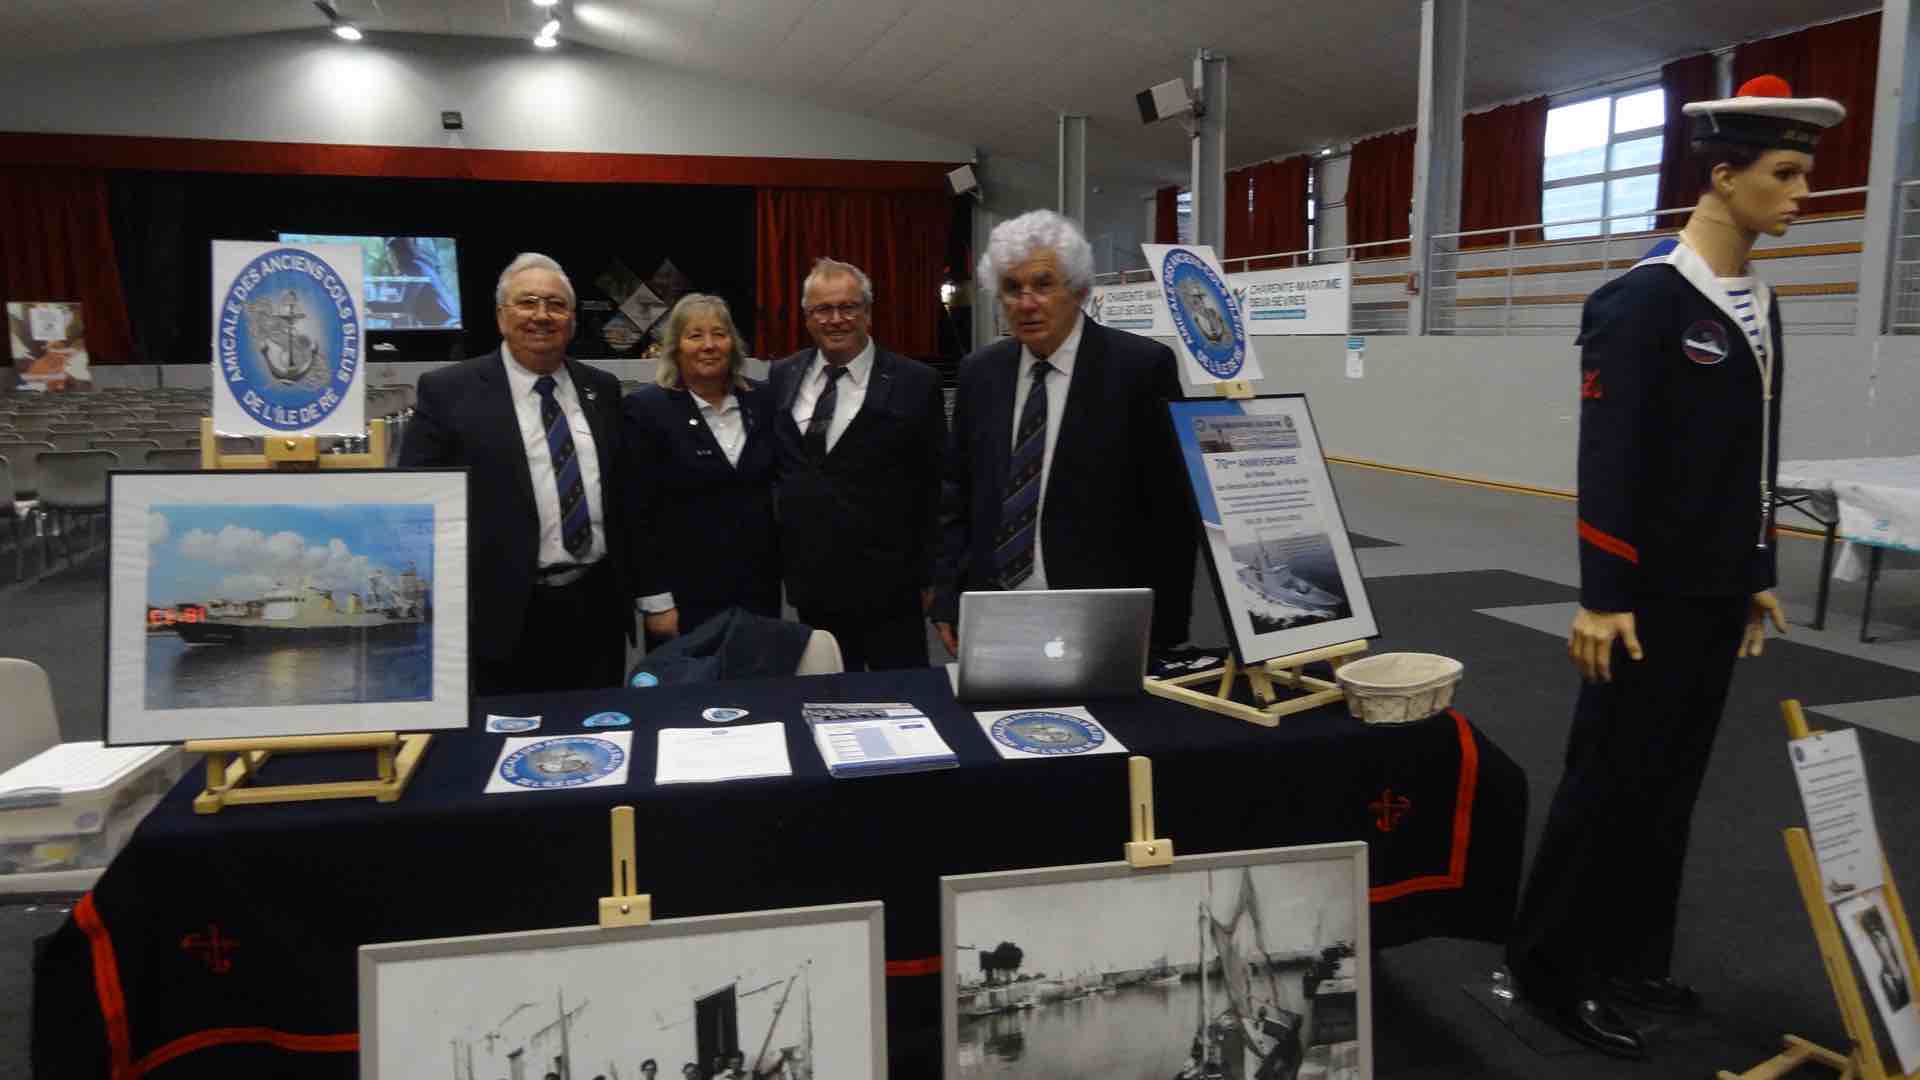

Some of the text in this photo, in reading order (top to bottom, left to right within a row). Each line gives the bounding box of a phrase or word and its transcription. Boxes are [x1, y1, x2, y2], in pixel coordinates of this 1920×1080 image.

[222, 255, 357, 383] AMICALE DES ANCIENS COLS BLEUS
[243, 389, 265, 414] DE
[300, 403, 320, 423] DE
